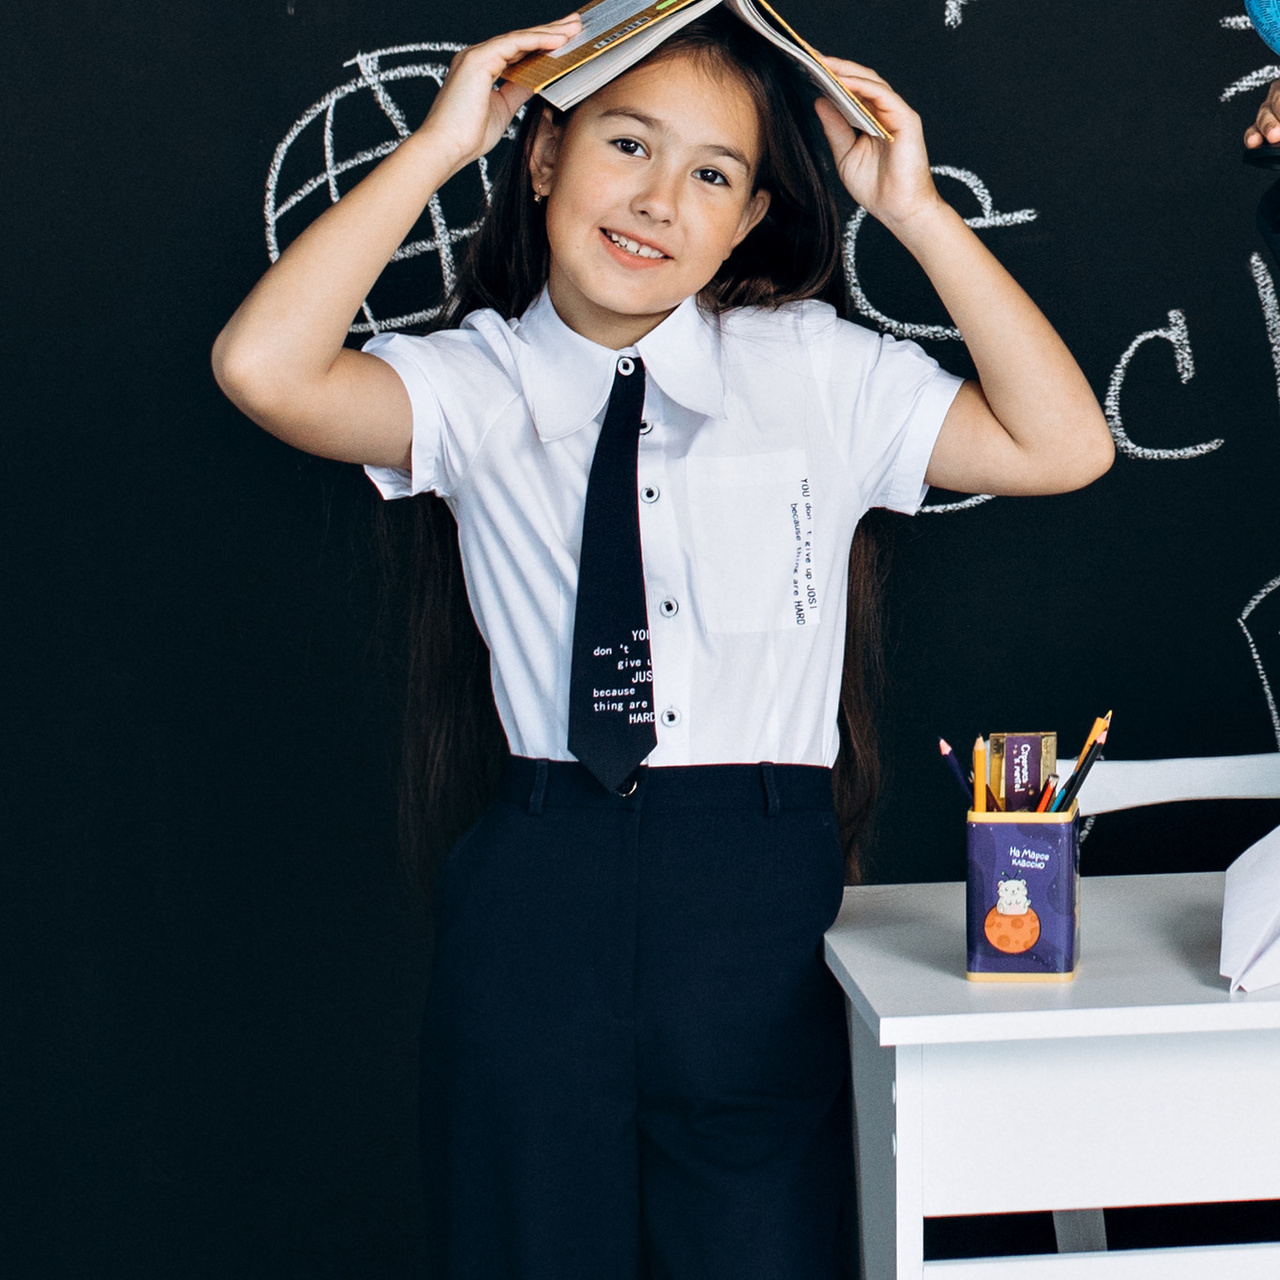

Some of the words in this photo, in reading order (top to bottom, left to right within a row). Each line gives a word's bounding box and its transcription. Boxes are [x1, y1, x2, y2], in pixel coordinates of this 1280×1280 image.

[800, 478, 810, 498] YOU
[804, 502, 812, 520] don
[790, 502, 803, 541] because
[805, 568, 813, 580] up
[792, 579, 801, 596] are
[793, 600, 806, 625] HARD
[593, 646, 612, 656] don
[617, 658, 642, 670] give
[631, 670, 653, 684] JUS
[593, 687, 636, 698] because
[593, 700, 624, 712] thing
[629, 700, 648, 710] are
[629, 712, 656, 724] HARD
[1009, 846, 1021, 858] На
